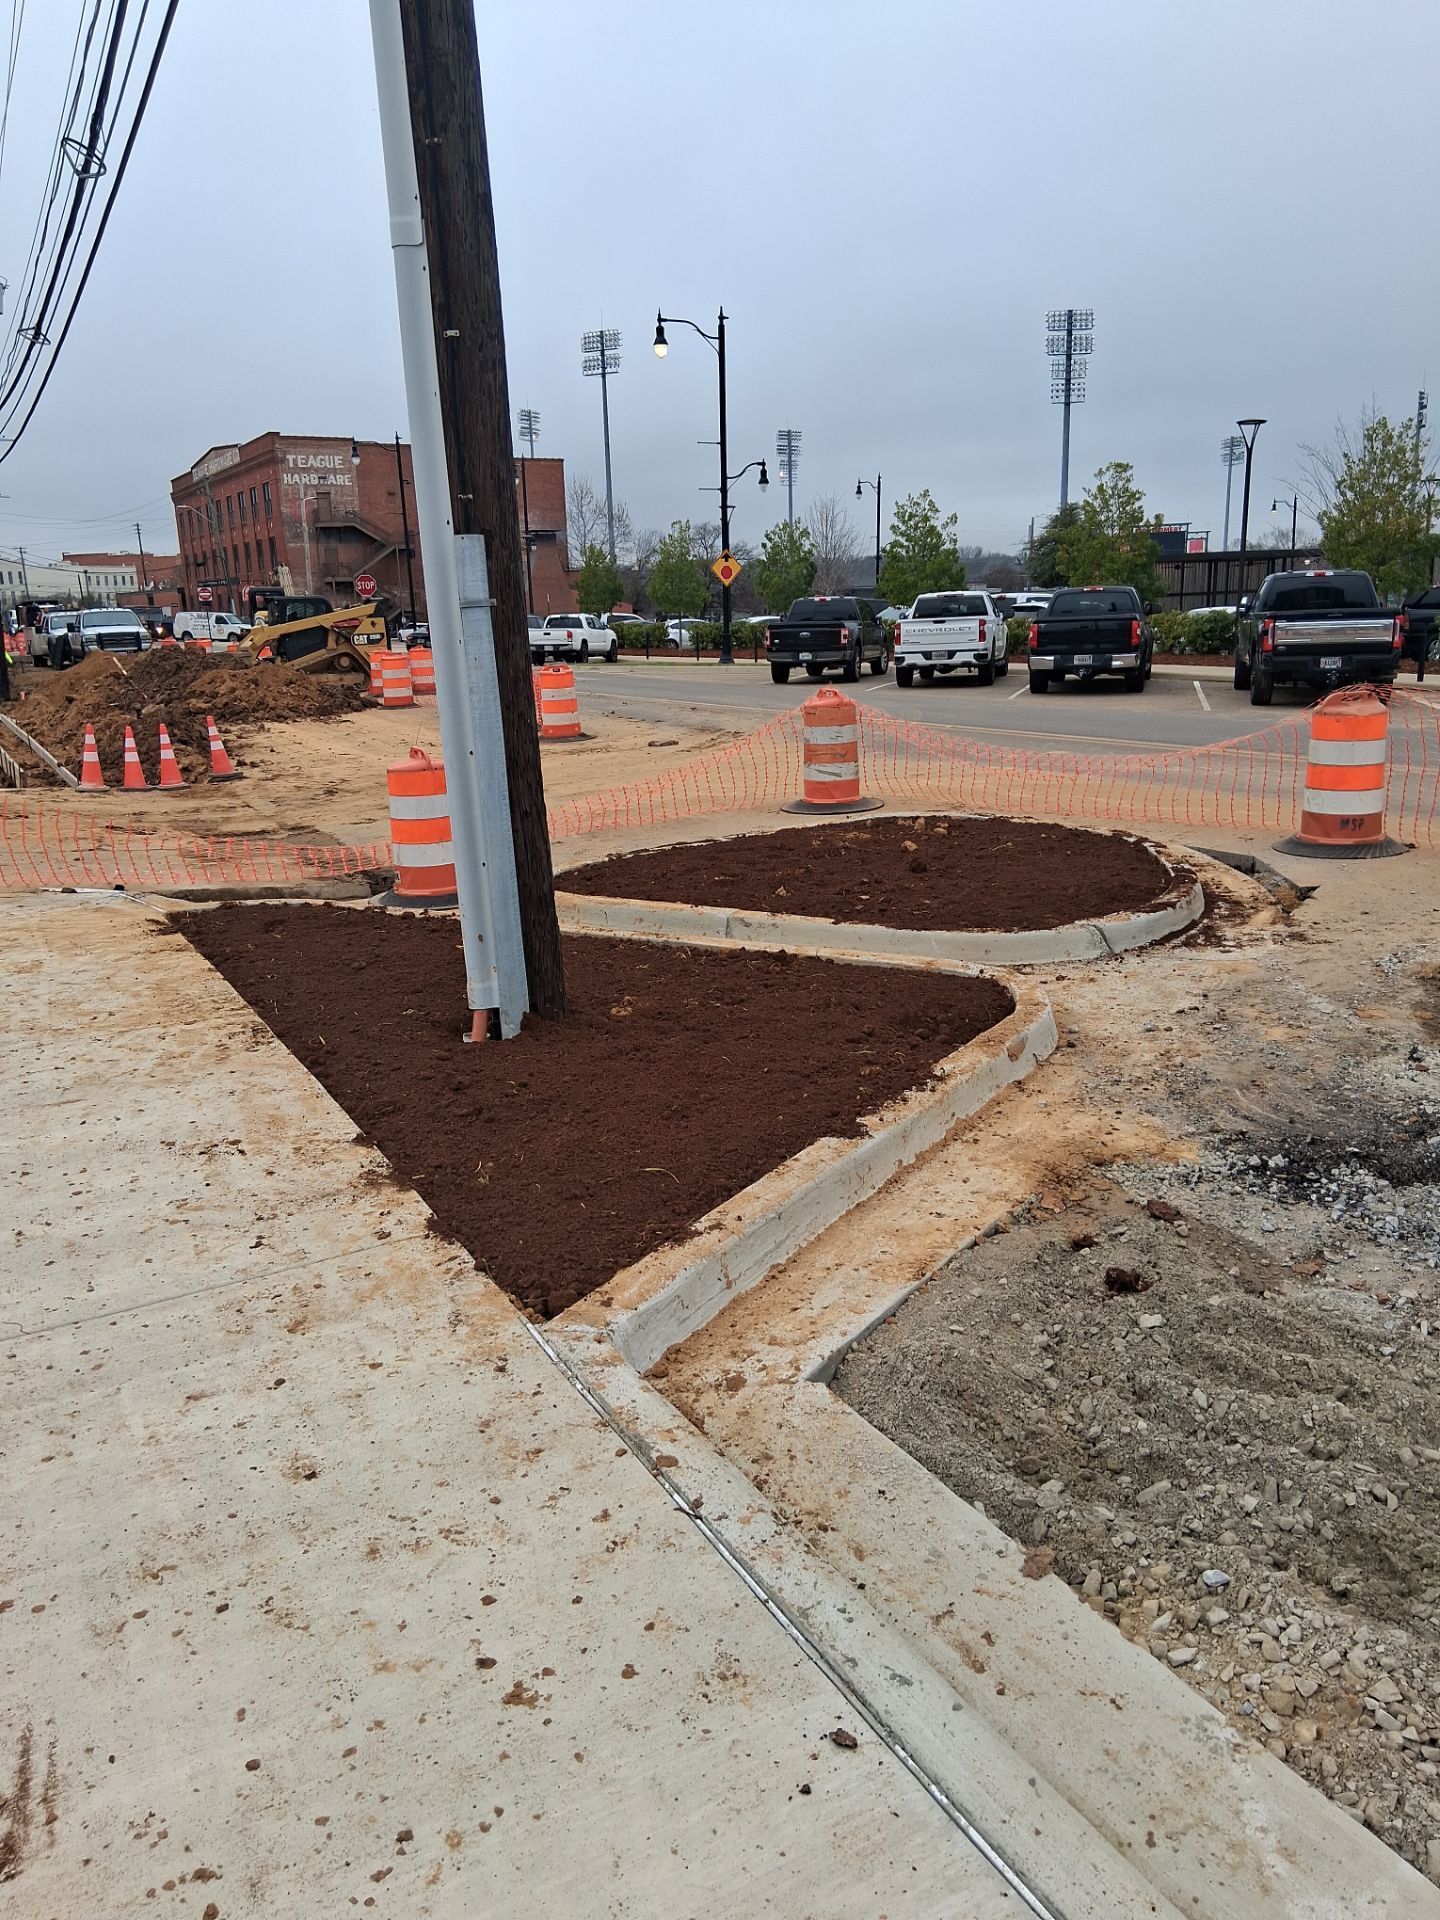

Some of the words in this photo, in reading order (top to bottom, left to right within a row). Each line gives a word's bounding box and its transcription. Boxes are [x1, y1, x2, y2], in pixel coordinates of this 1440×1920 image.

[286, 455, 344, 468] TEAGUE
[357, 581, 375, 590] STOP
[905, 626, 972, 634] CHEVROLET
[353, 634, 368, 645] CAT
